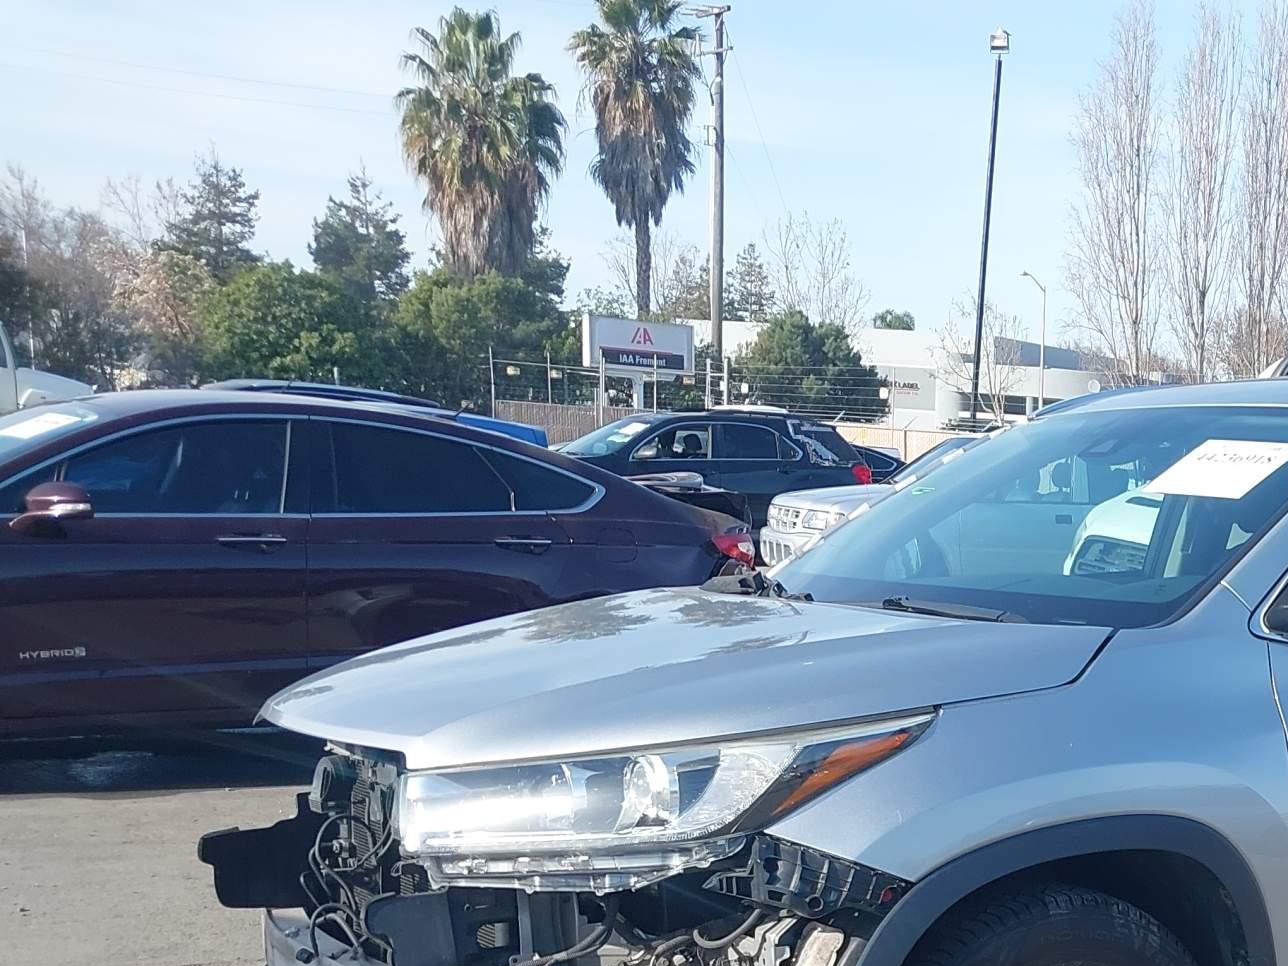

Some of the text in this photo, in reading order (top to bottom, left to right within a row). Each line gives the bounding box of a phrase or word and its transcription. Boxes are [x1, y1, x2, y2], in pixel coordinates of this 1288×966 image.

[619, 353, 666, 367] IAA Fremnt
[19, 648, 74, 659] HYBRID
